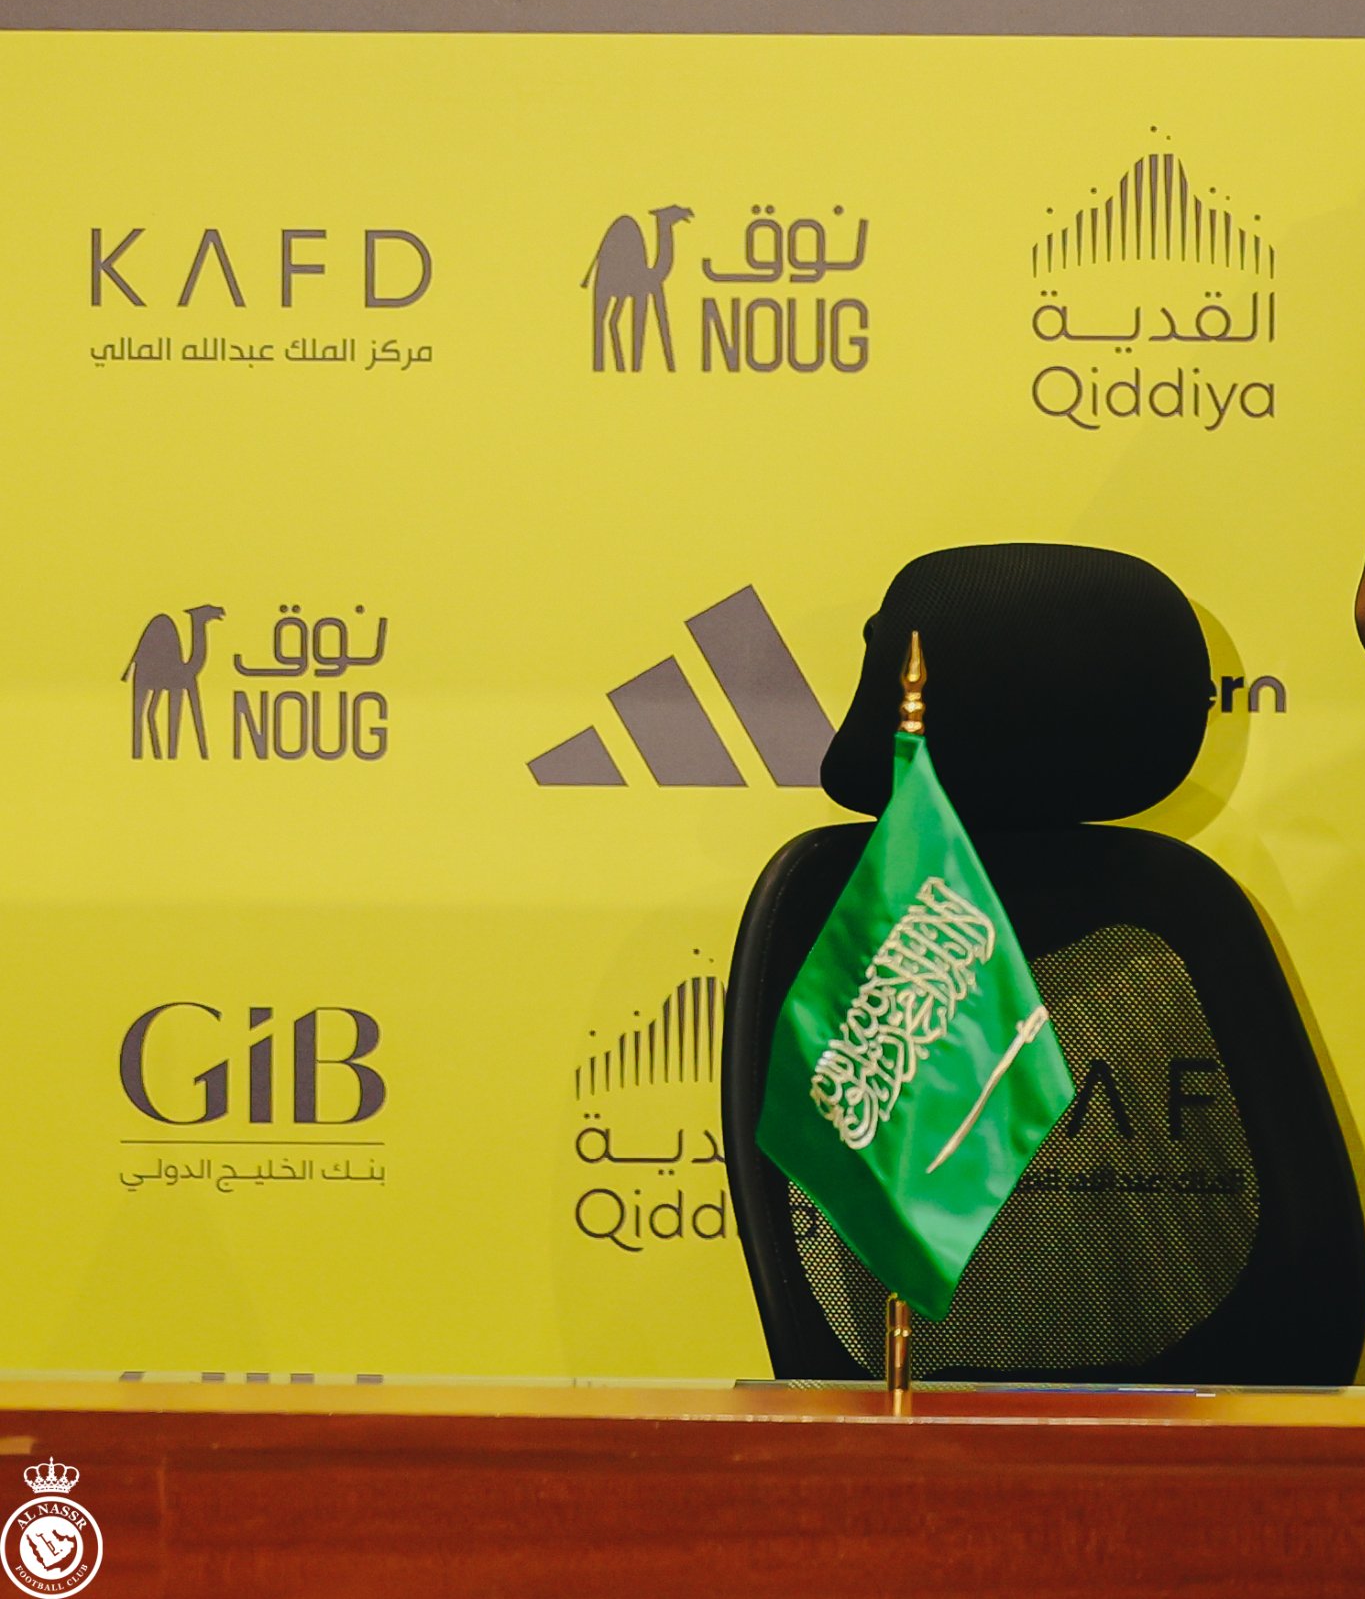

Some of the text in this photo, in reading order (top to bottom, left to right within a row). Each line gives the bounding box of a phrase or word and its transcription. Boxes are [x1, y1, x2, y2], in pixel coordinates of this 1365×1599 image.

[90, 227, 433, 309] KAFD
[701, 204, 869, 284] نوق
[90, 336, 433, 371] مركز الملك عبدالله المالي
[701, 297, 869, 374] NOUG
[1031, 365, 1275, 432] Qiddiya
[233, 604, 388, 678] نوق
[232, 689, 388, 761] NOUG
[1067, 1059, 1218, 1139] AF
[575, 1188, 727, 1252] Qidd
